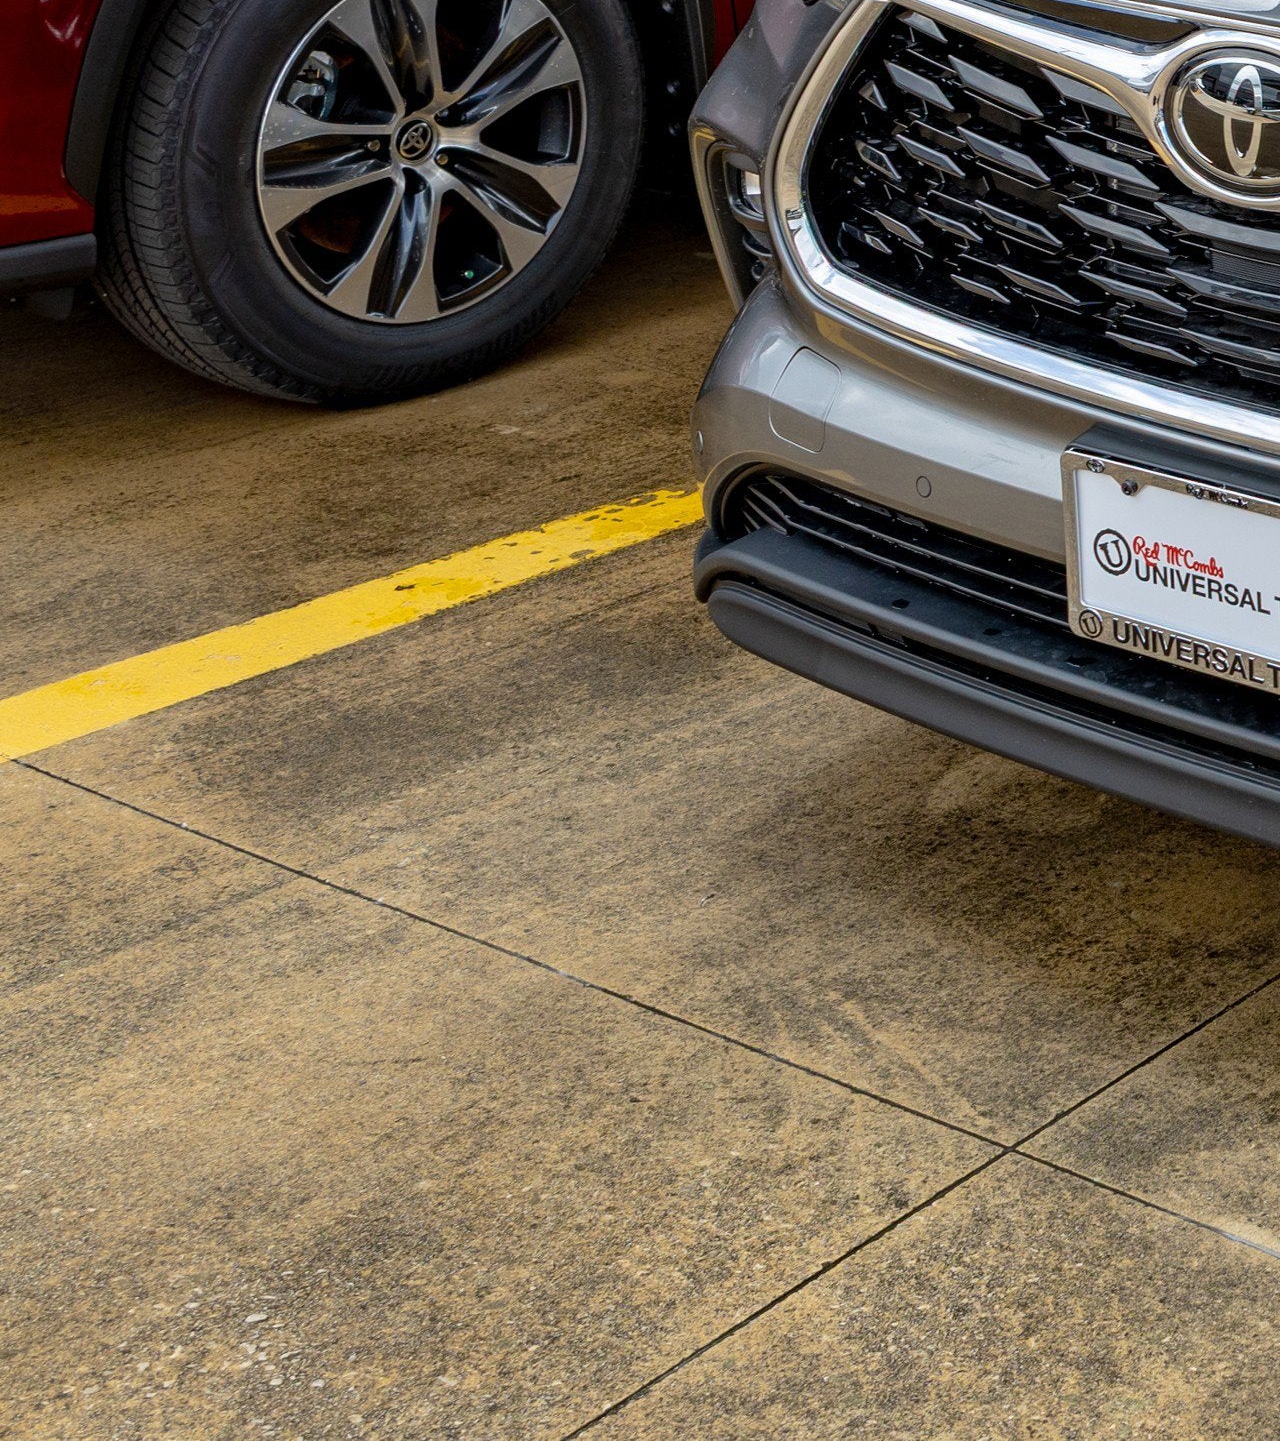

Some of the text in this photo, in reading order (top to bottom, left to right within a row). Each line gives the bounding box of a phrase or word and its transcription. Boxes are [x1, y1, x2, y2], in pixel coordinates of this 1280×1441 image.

[1133, 535, 1224, 578] Red McCombs
[1135, 559, 1271, 616] UNIVERSAL
[1112, 617, 1264, 684] UNIVERSAL
